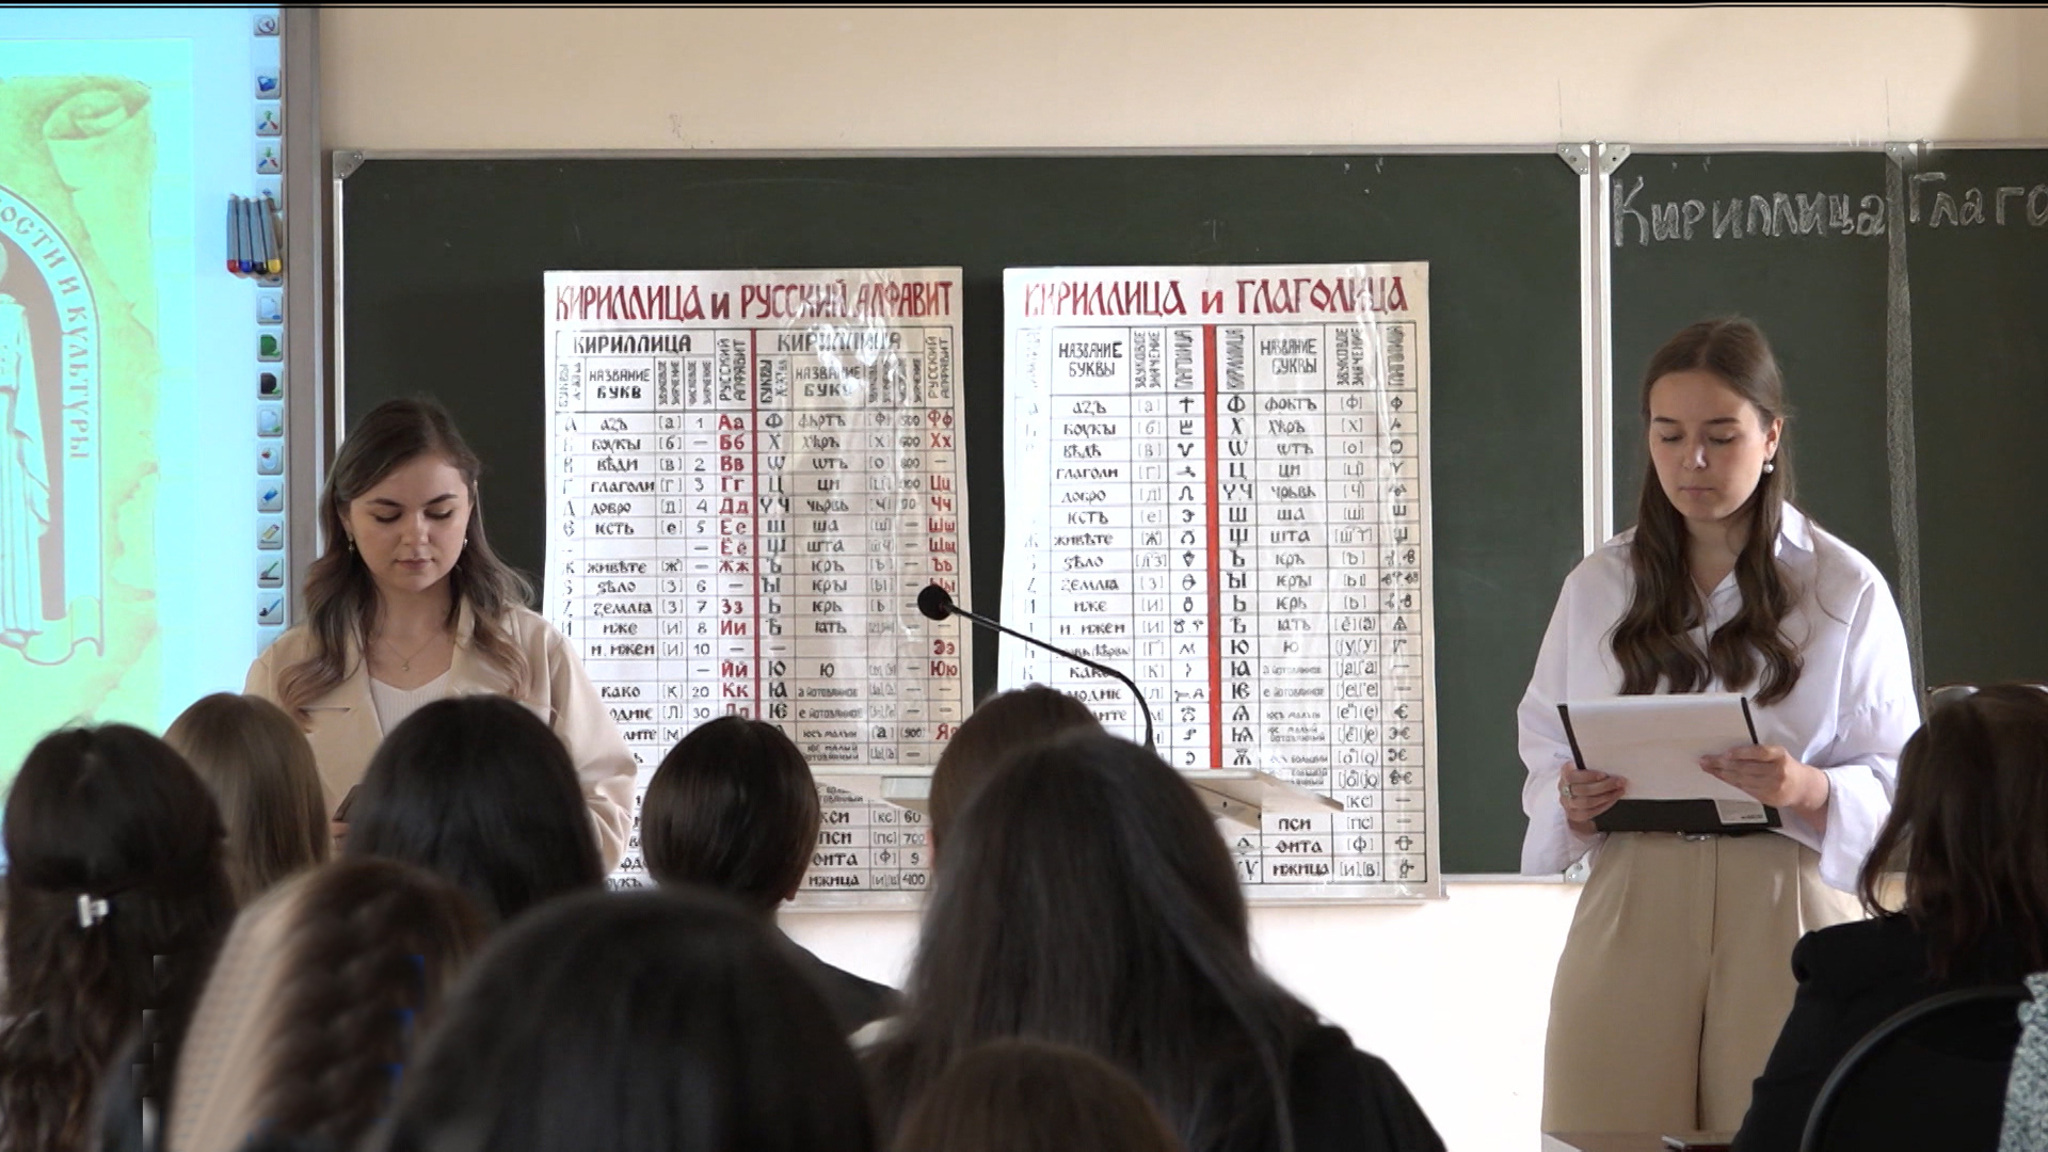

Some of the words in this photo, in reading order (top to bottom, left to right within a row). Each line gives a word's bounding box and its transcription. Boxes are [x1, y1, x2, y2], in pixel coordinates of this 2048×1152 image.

[1614, 176, 1886, 246] Кириллица
[556, 285, 705, 322] КИРИЛЛИЦА
[741, 279, 848, 319] РУССКИЙ
[857, 281, 952, 318] АЛФАВИТ
[1024, 281, 1188, 318] КИРИЛЛИЦА
[1236, 277, 1409, 315] ГЛАГОЛИЦА
[0, 206, 67, 268] ОСТИ
[62, 306, 89, 458] КУЛЬТУРЫ
[574, 335, 691, 354] КИРИЛЛИЦА
[1059, 341, 1123, 358] НАЗВАНИЕ
[1261, 338, 1317, 356] НАЗВАНИЕ
[589, 368, 650, 382] НАЗВАНИЕ
[1069, 362, 1115, 377] БУКВЫ
[597, 386, 641, 399] БУКВ
[695, 643, 709, 655] 10
[692, 686, 709, 697] 20
